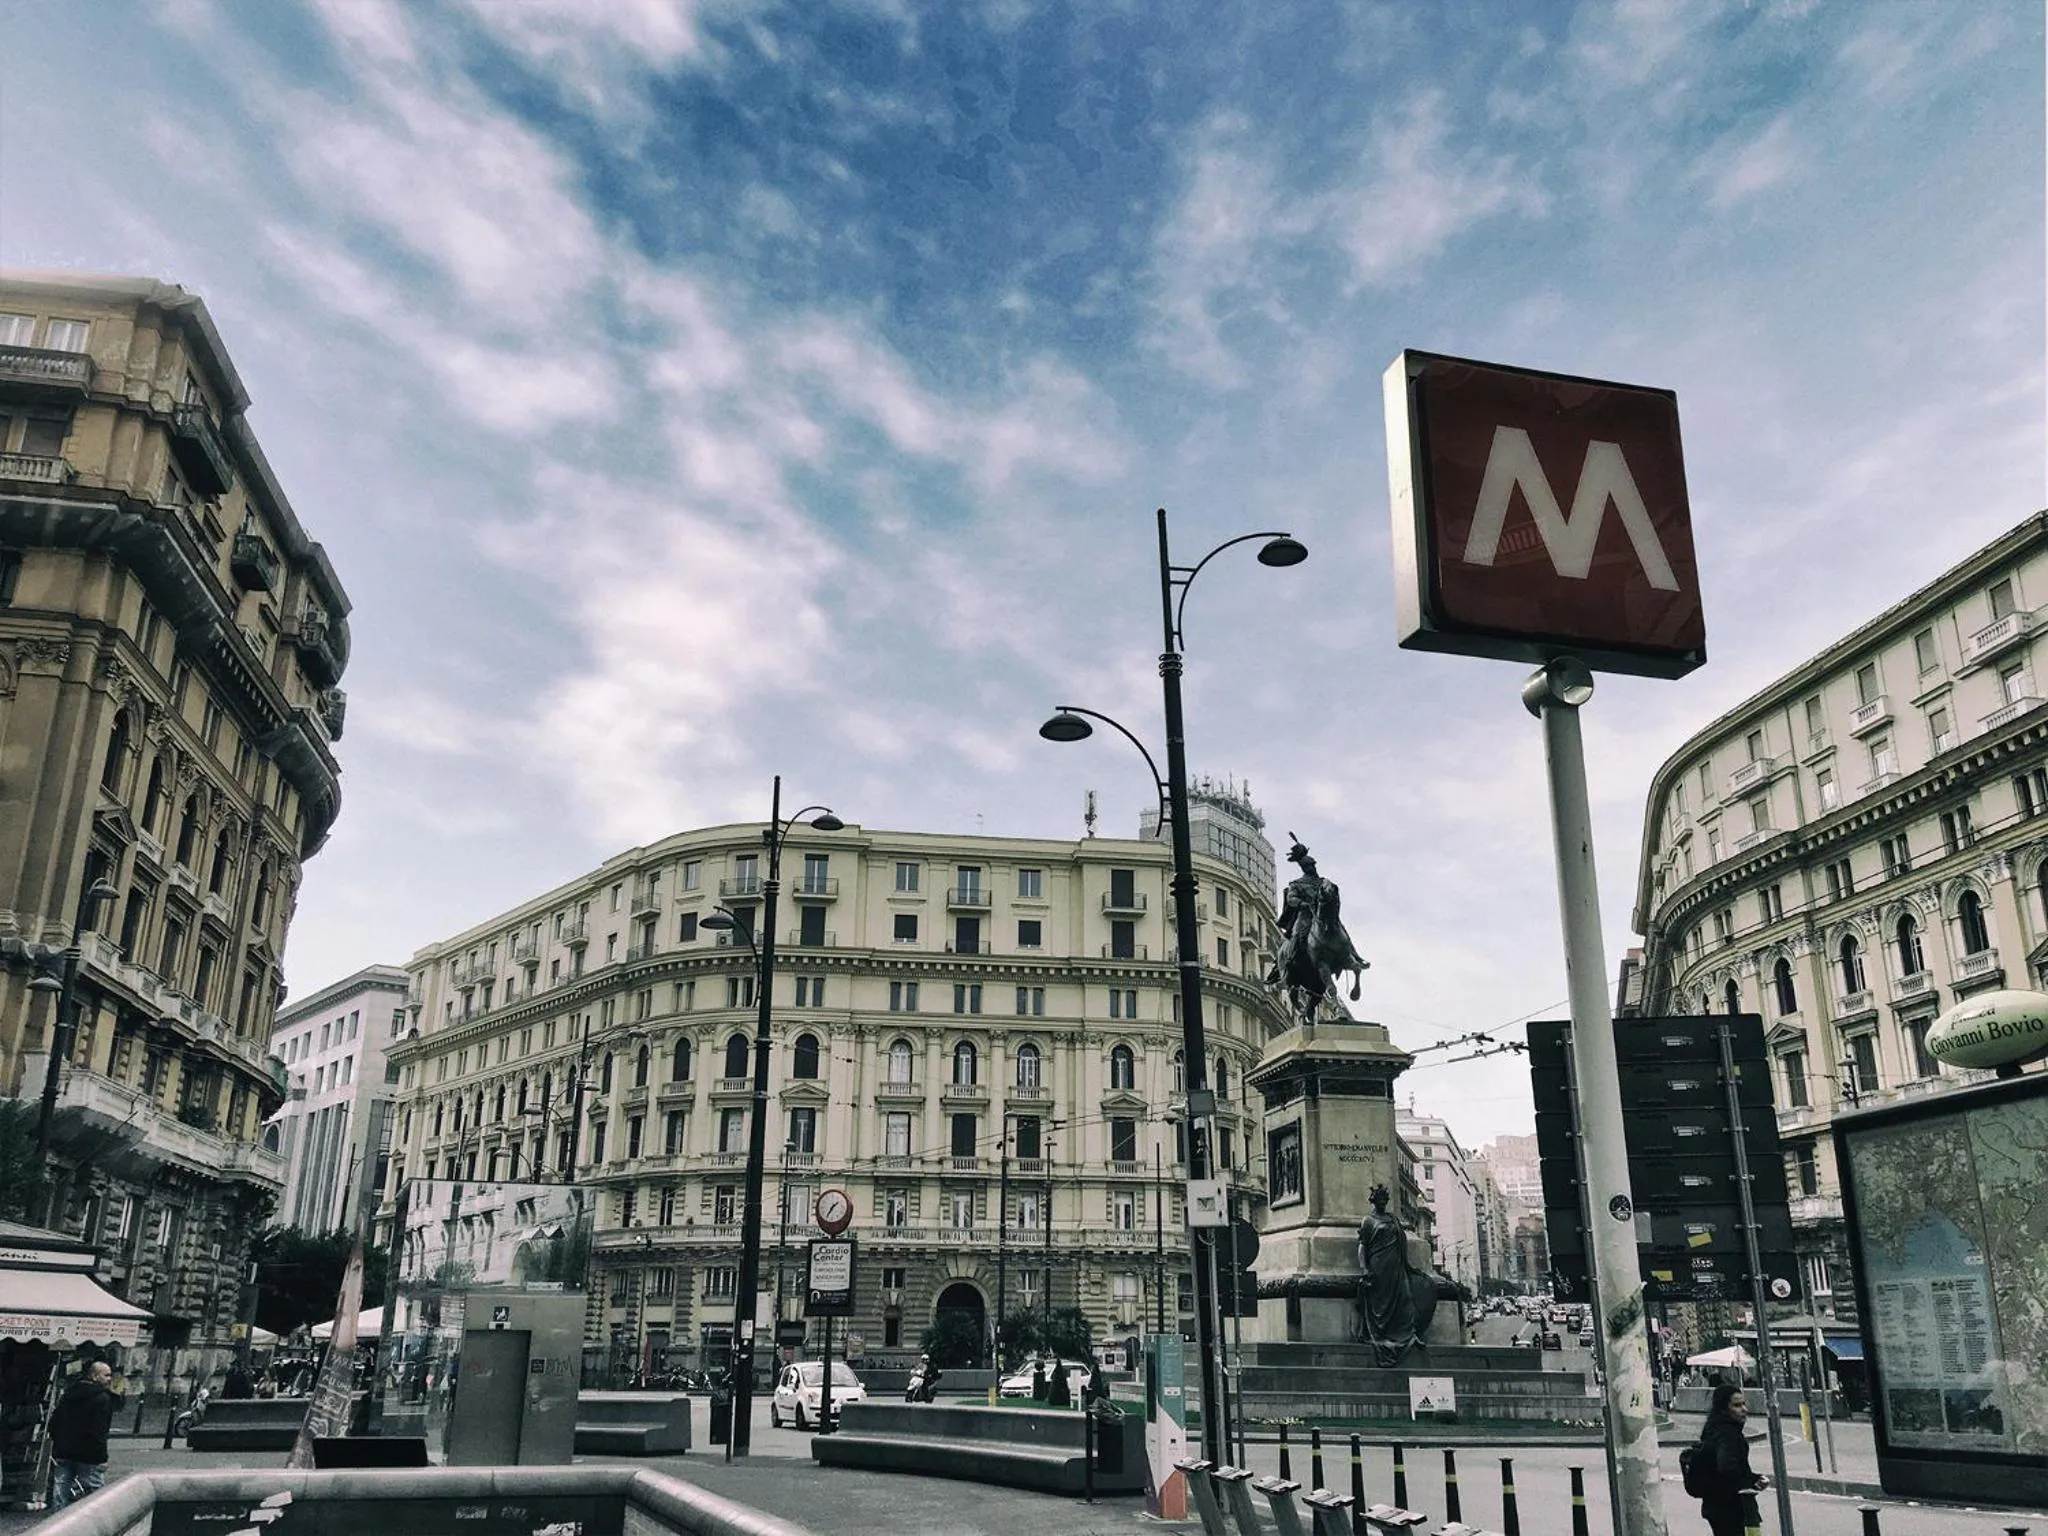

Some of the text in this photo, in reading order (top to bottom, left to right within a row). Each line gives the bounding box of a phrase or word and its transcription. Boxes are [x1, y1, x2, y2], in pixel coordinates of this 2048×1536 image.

[1463, 425, 1681, 592] M
[1930, 1015, 2044, 1055] Giovanni Bovio
[819, 1245, 849, 1254] Cardio
